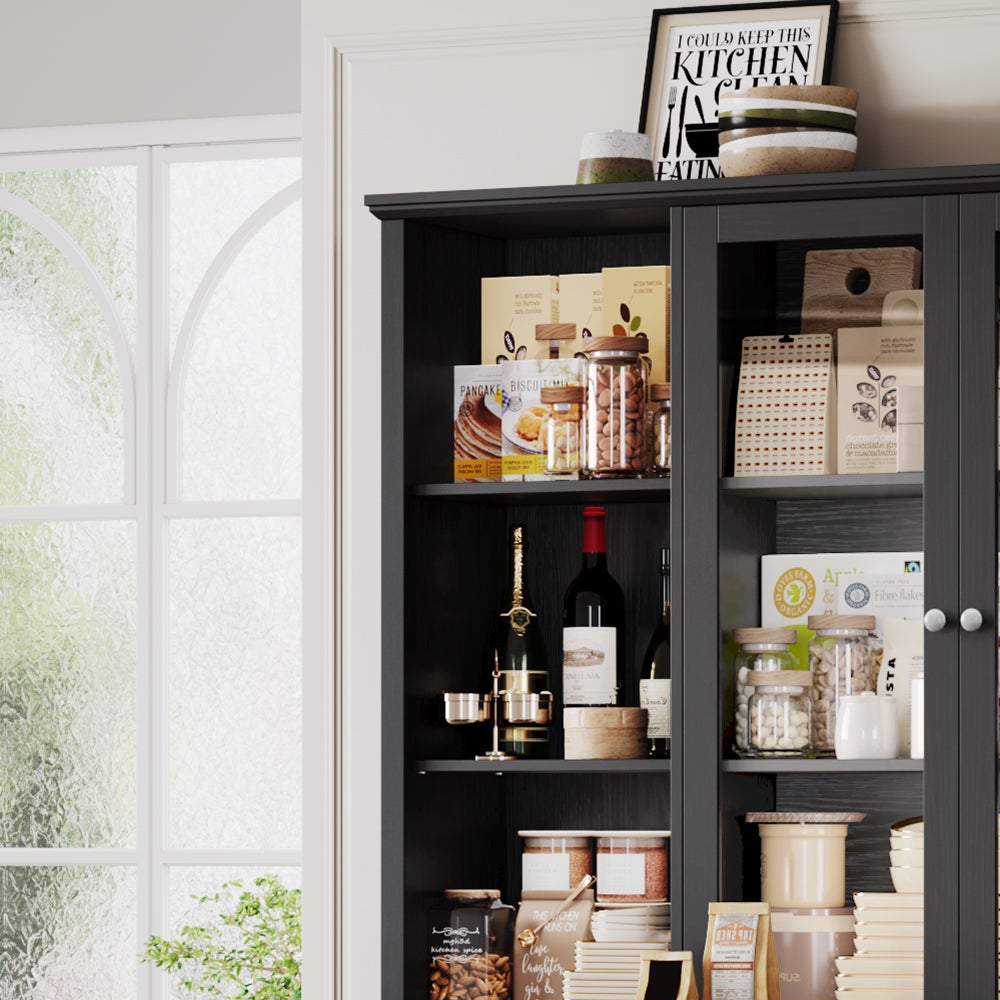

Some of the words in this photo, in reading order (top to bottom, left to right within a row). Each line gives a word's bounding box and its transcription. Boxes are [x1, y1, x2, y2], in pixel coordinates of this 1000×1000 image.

[677, 34, 683, 49] I
[686, 31, 734, 48] COULD
[737, 29, 774, 45] KEEP
[778, 26, 811, 43] THIS
[672, 43, 813, 86] KITCHEN
[656, 158, 725, 181] EATIN
[875, 588, 898, 600] Fibre
